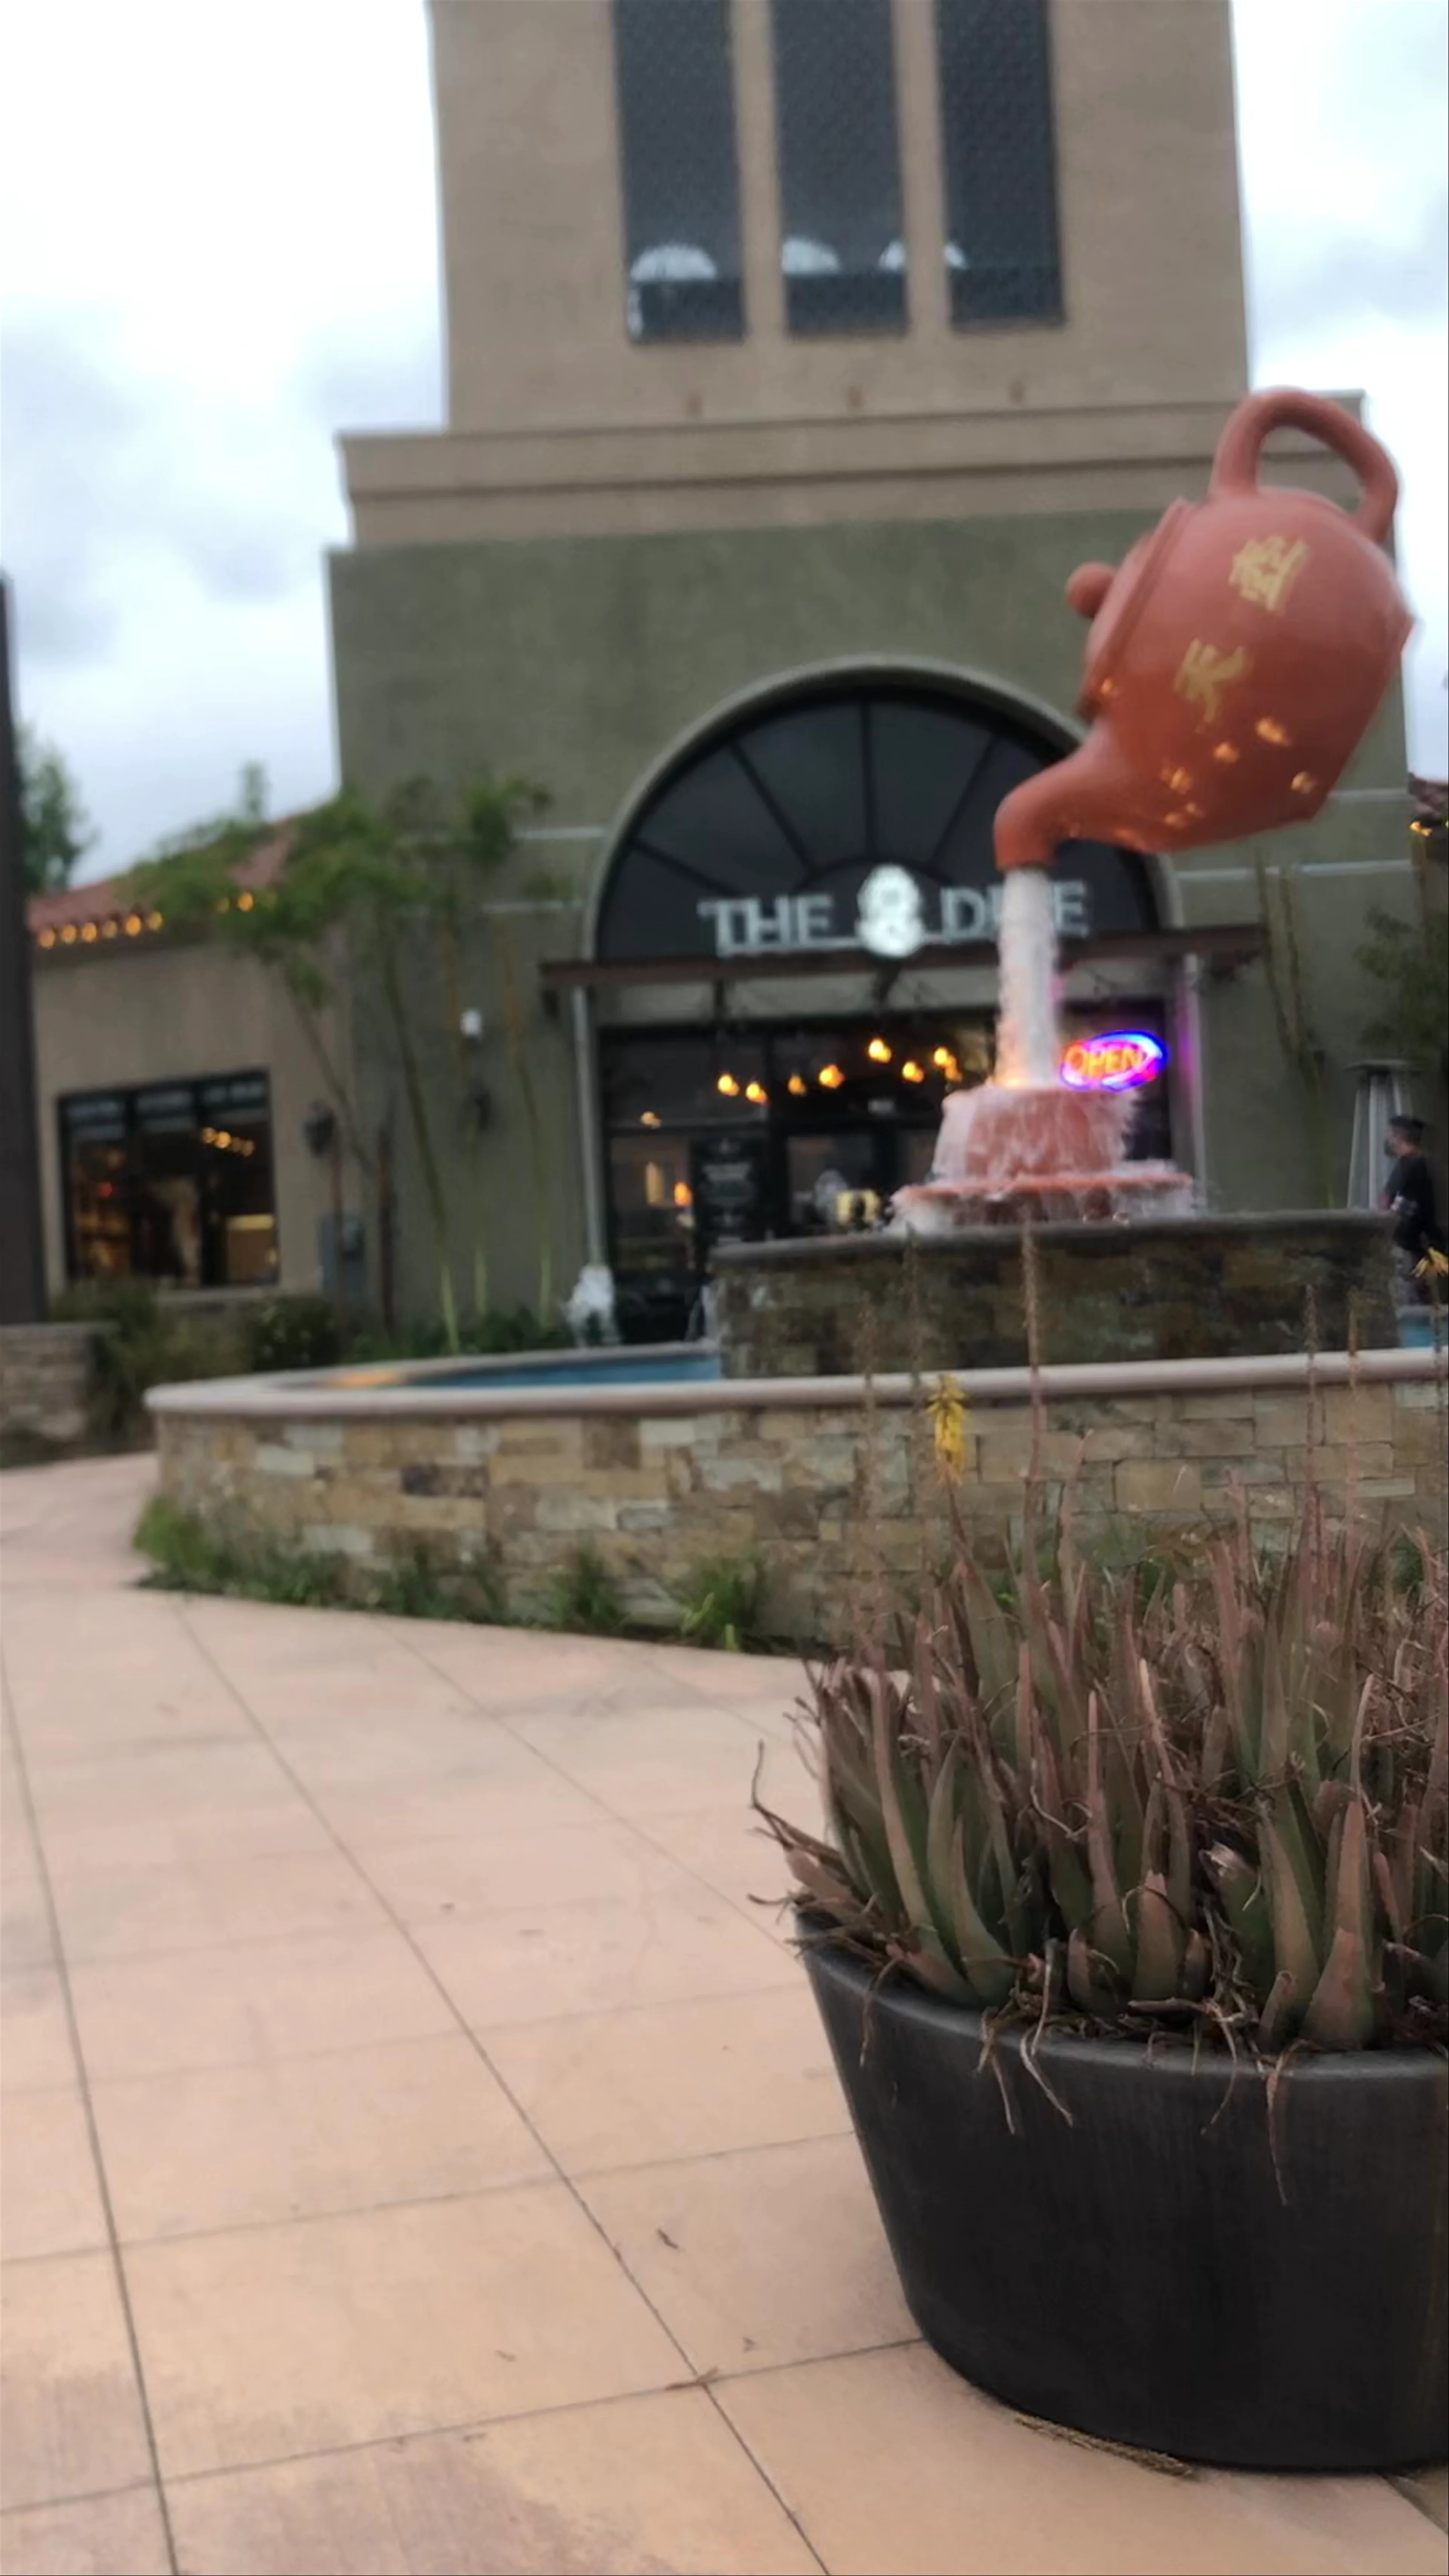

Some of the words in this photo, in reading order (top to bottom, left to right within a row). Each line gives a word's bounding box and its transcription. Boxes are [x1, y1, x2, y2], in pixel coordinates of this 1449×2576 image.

[696, 893, 833, 958] THE
[855, 863, 924, 958] 8
[940, 879, 1089, 945] DIE
[1066, 1044, 1143, 1078] OPEN
